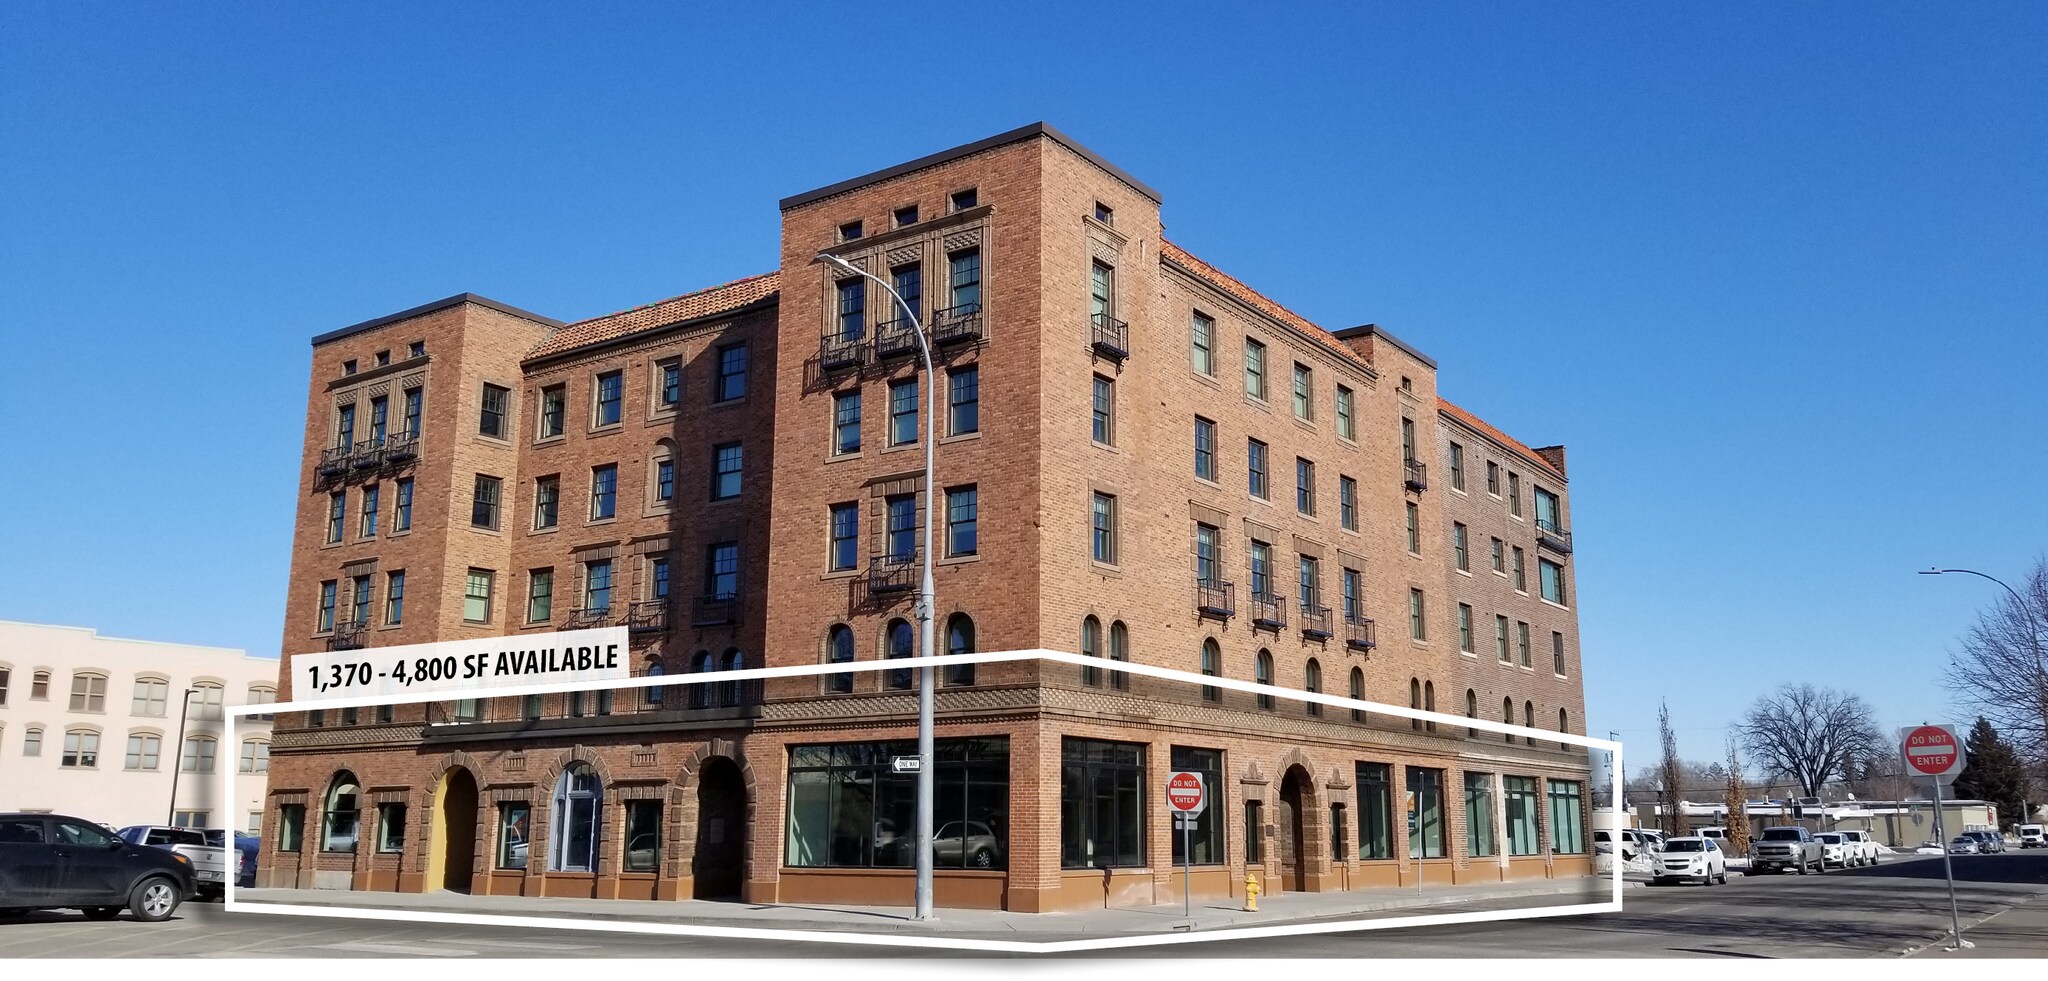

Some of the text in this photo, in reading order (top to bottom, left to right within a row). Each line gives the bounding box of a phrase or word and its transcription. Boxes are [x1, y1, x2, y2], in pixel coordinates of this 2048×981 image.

[1911, 734, 1947, 745] DO NOT
[1917, 756, 1948, 766] ENTER
[1174, 796, 1195, 804] ENTER
